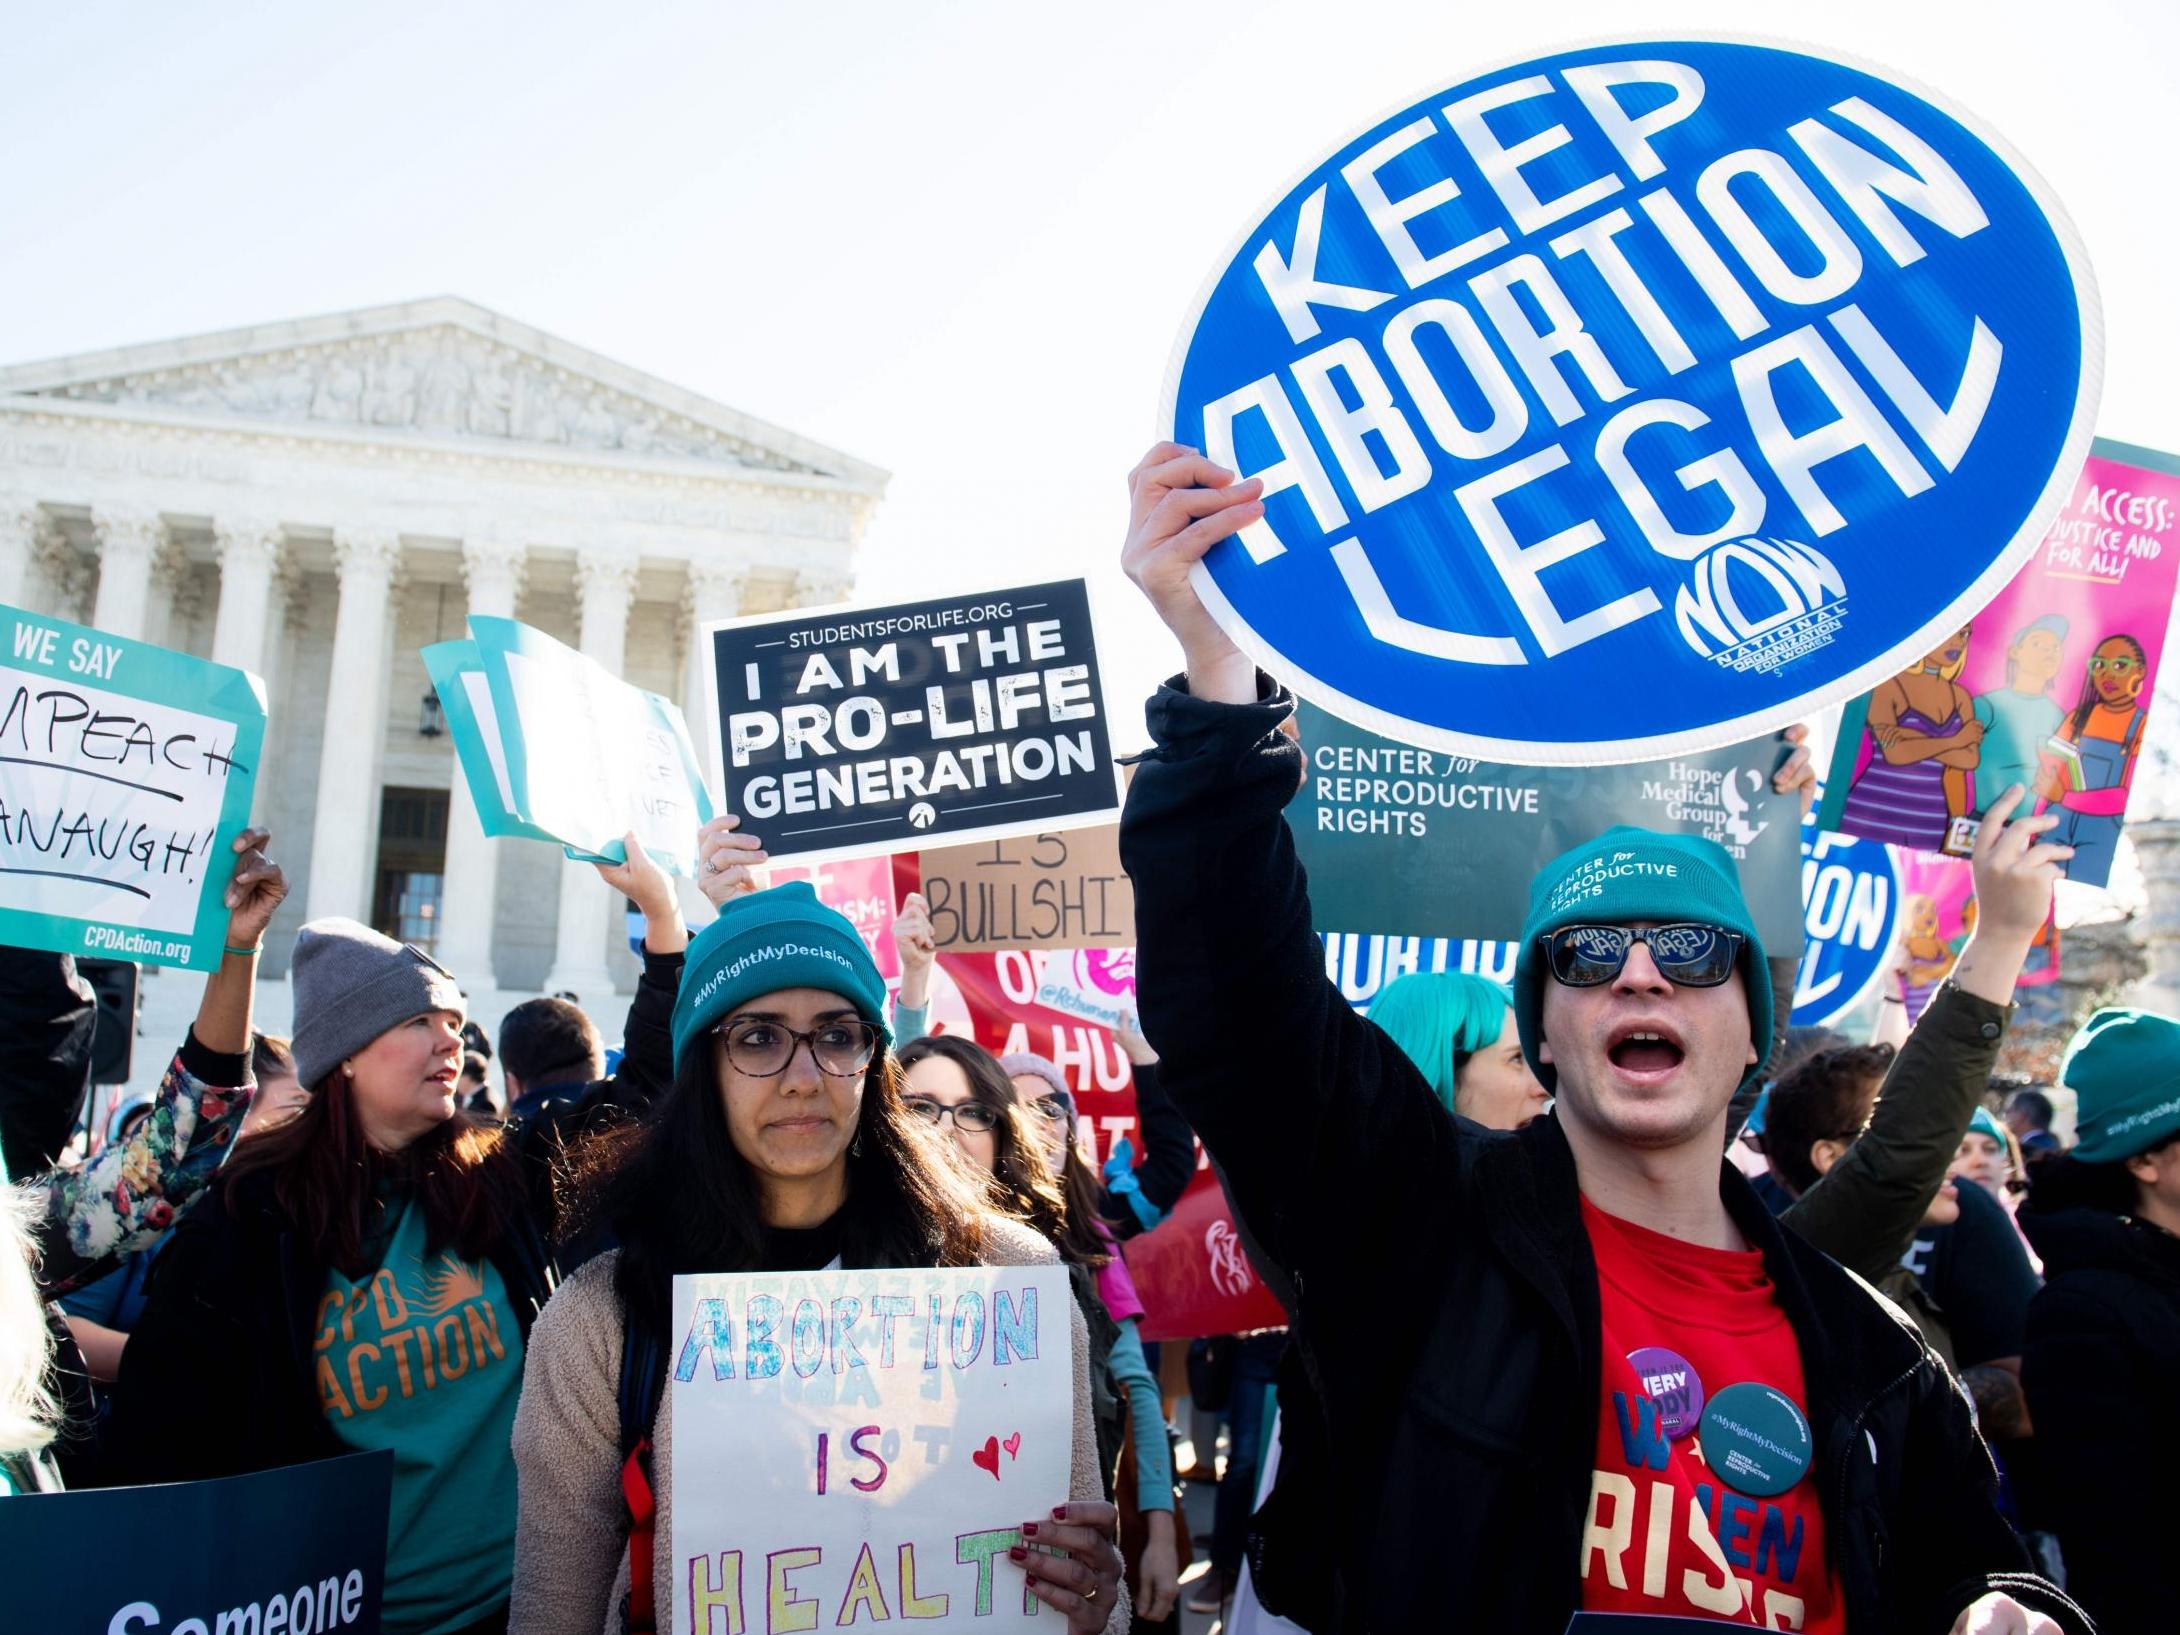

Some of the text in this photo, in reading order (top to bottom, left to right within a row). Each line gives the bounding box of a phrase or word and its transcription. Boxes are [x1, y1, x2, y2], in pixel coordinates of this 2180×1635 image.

[1253, 60, 1705, 344] KEEP
[1202, 95, 1991, 566] ABORTION
[1329, 304, 2003, 666] LEGAL
[2082, 484, 2175, 533] ACCESS:
[2047, 541, 2082, 568] FOR
[2049, 520, 2162, 560] JUSTICE AND
[1675, 537, 1847, 658] NOW
[789, 602, 1013, 648] STUDENTSFORLIFE.ORG
[1716, 605, 1846, 665] NATIONAL
[1733, 619, 1842, 671] ORGANIZATION
[13, 622, 123, 680] WE SAY
[745, 619, 1066, 700] I AM THE
[1755, 634, 1833, 671] FOR WOMEN
[729, 664, 1095, 767] PRO-LIFE
[743, 731, 1095, 819] GENERATION
[1315, 746, 1481, 777] CENTER for
[1669, 762, 1723, 790] Hope
[1316, 777, 1539, 813] REPRODUCTIVE
[1640, 781, 1720, 806] Medical
[1666, 802, 1727, 831] Group
[1317, 807, 1427, 837] RIGHTS
[976, 831, 1067, 868] IS
[1610, 851, 1636, 866] for
[926, 876, 1130, 946] BULLSHI
[1551, 863, 1678, 910] REPRODUCTIVE
[84, 926, 192, 964] CPDAction.org
[694, 943, 853, 1007] #MyRightMyDecision
[313, 1268, 409, 1349] CPD
[317, 1299, 505, 1417] ACTION
[674, 1287, 1039, 1382] ABORTION
[816, 1425, 888, 1496] IS
[1711, 1413, 1802, 1465] #MyRightMyDecision
[1729, 1450, 1753, 1464] CENTER
[1725, 1461, 1747, 1475] RIGHTS
[1727, 1455, 1771, 1481] REPRODUCTIVE
